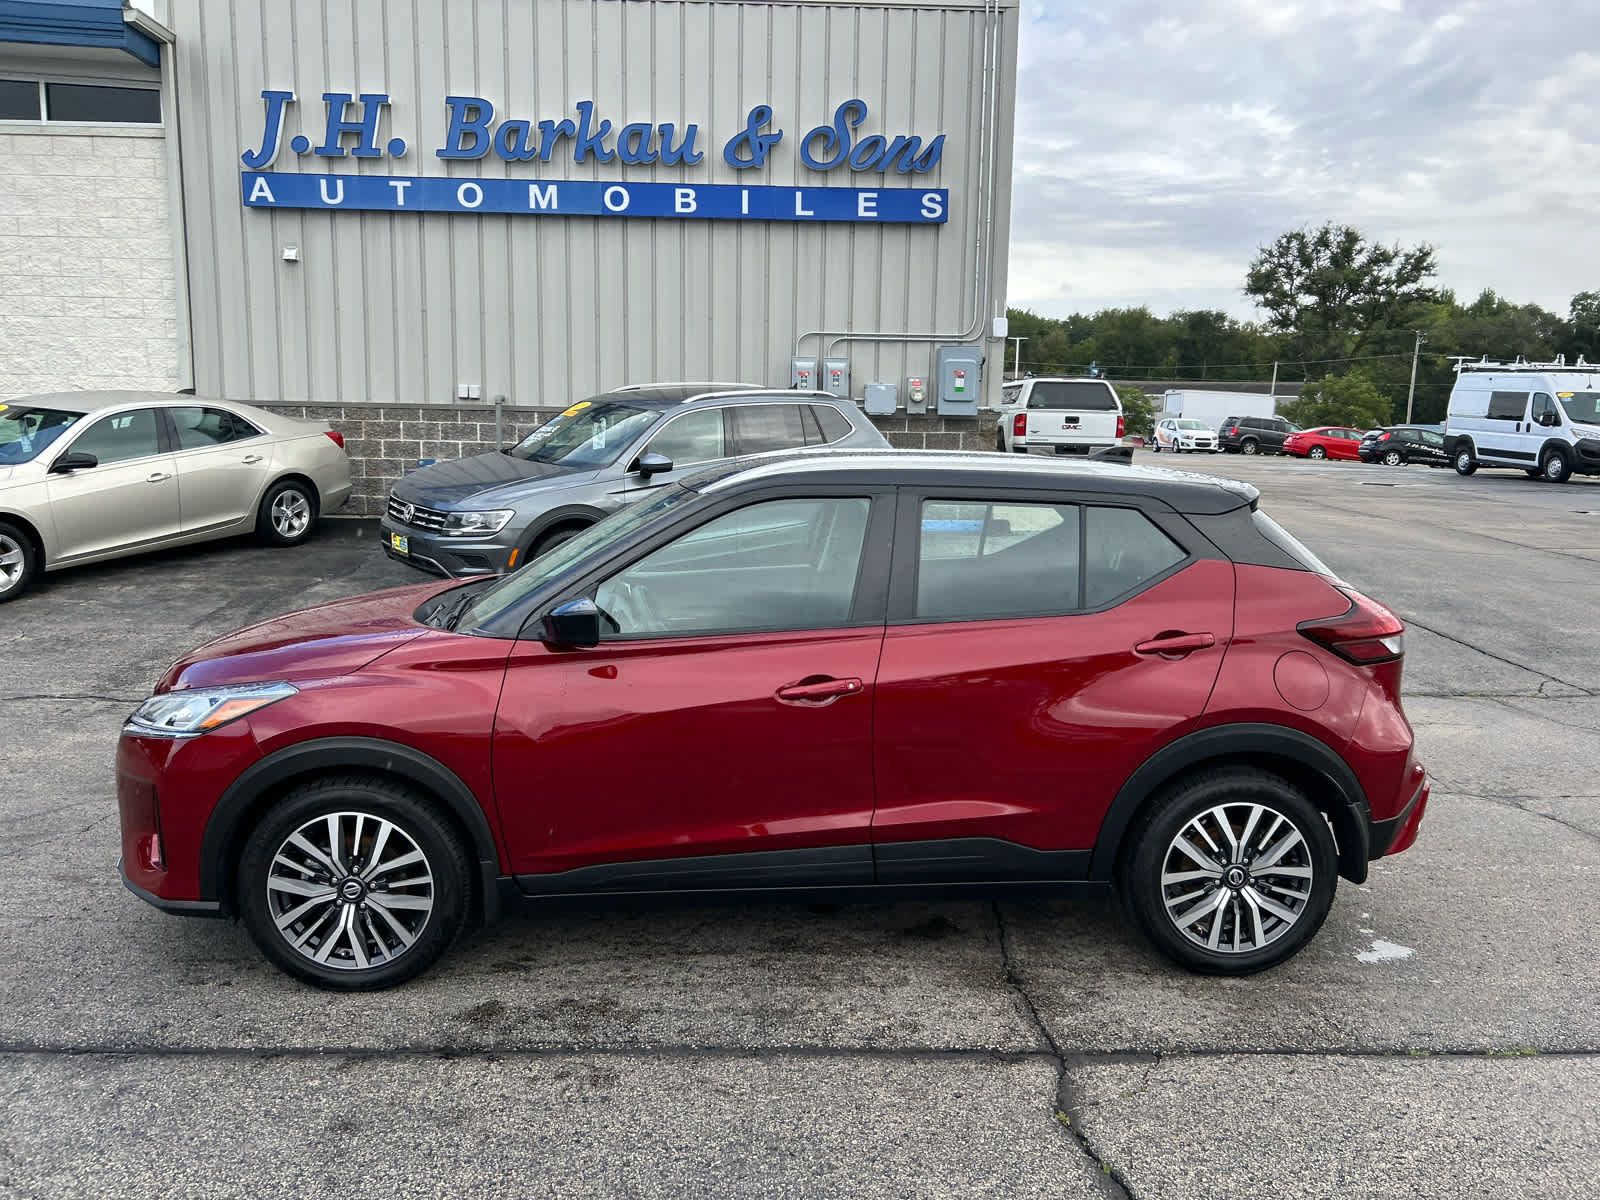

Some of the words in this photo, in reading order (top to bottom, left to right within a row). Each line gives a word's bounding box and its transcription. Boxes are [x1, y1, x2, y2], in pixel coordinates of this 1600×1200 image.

[240, 90, 408, 169] J.H.
[435, 96, 704, 166] Barkau
[723, 104, 783, 169] &
[800, 98, 946, 174] Sons
[249, 176, 943, 219] AUTOMOBILES
